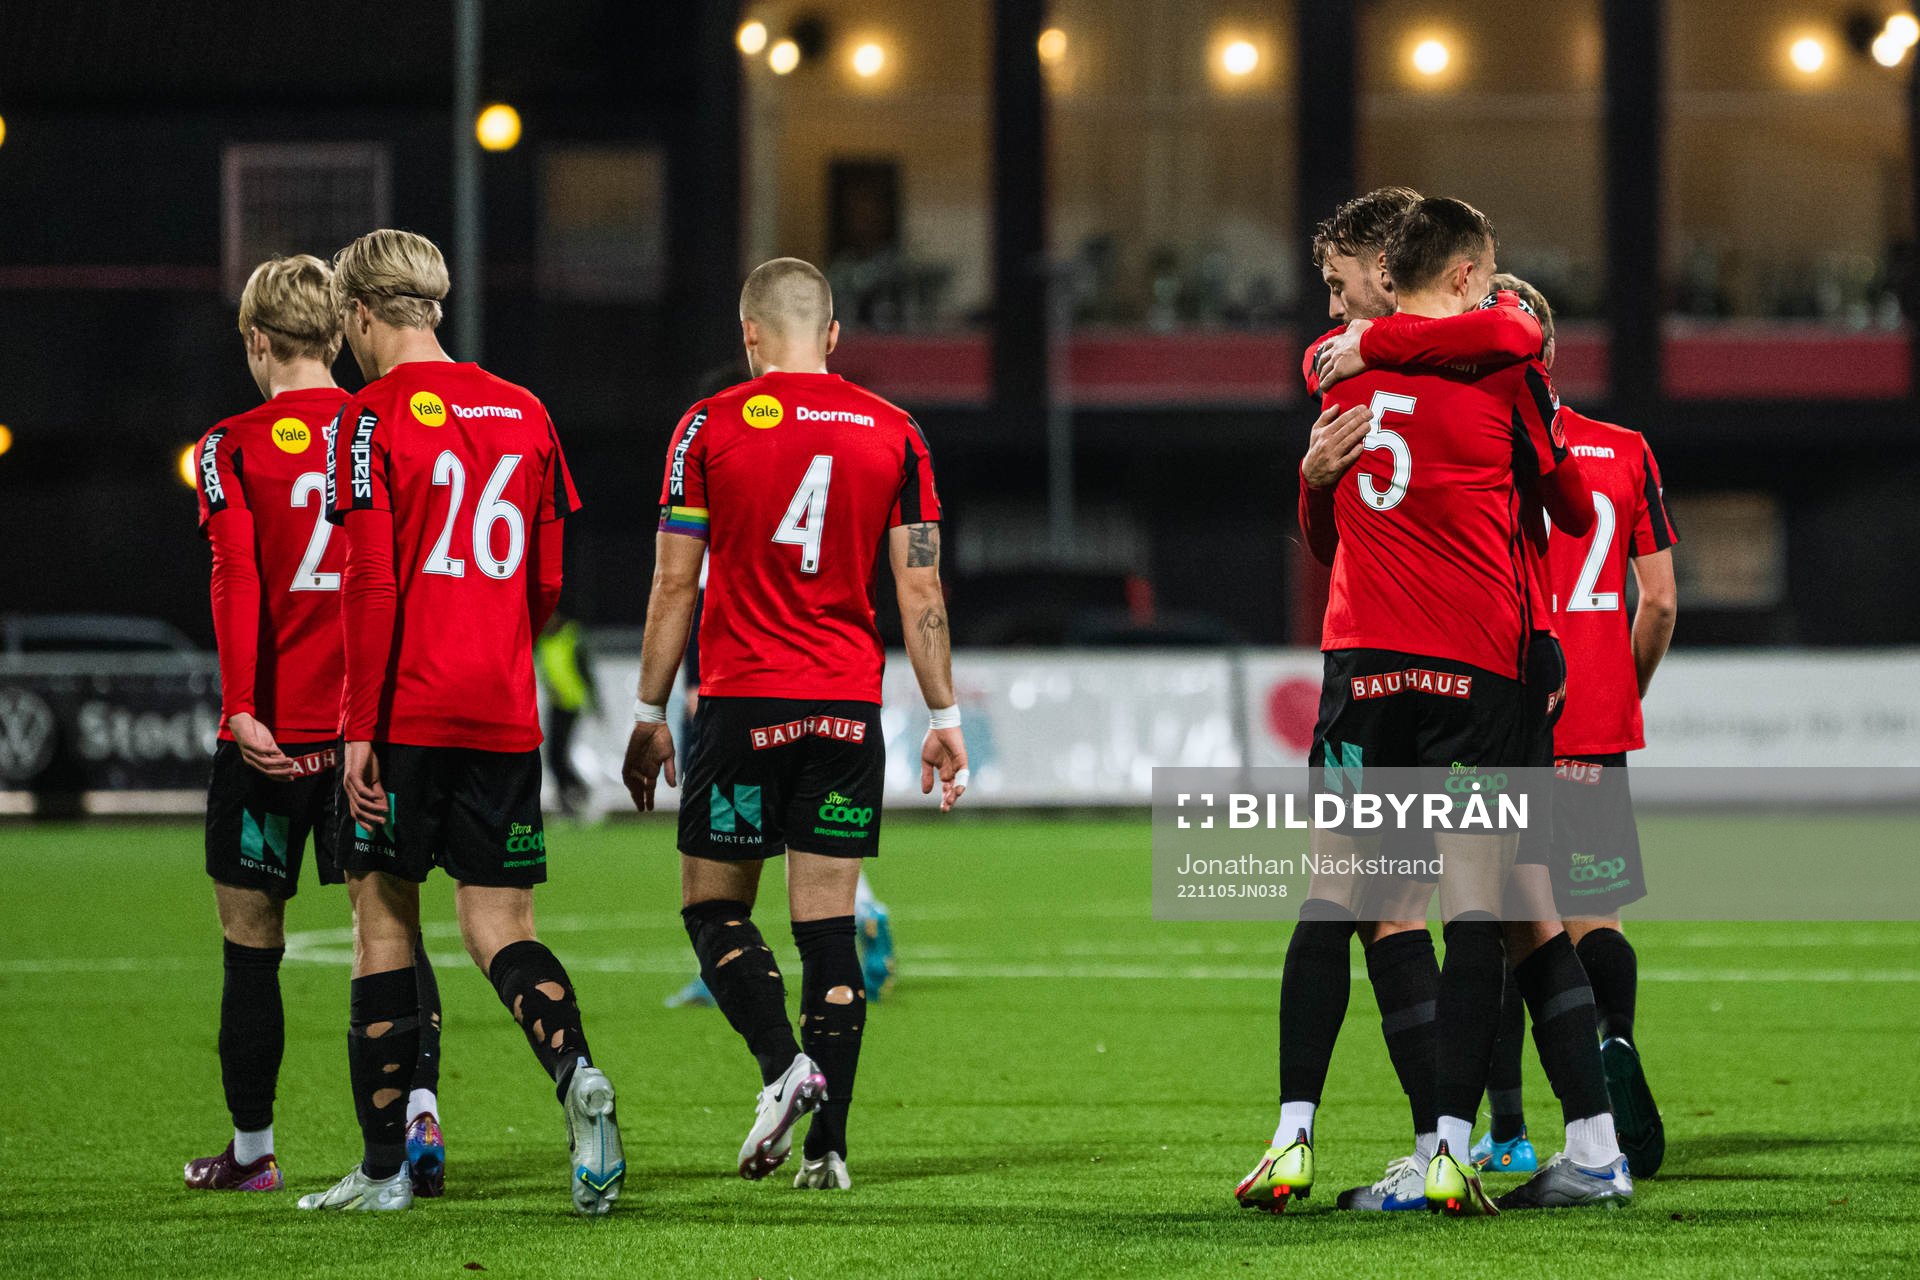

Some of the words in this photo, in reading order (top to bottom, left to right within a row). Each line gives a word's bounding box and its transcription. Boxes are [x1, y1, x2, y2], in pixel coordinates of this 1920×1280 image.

[413, 401, 444, 417] Yale
[451, 403, 523, 421] Doorman
[746, 403, 780, 418] Yale
[796, 406, 875, 427] Doorman
[274, 427, 307, 443] Yale
[351, 415, 378, 498] stadium
[669, 413, 707, 496] stadium
[1357, 390, 1417, 511] 5
[200, 432, 224, 503] stadium
[422, 449, 525, 580] 26
[771, 454, 833, 574] 4
[1354, 671, 1470, 697] BAUHAUS
[753, 718, 866, 748] BAUHAUS
[1449, 761, 1477, 775] Stora
[1444, 773, 1508, 795] coop
[819, 804, 873, 827] coop
[509, 822, 532, 836] Stora
[709, 832, 763, 845] NORTEAM
[1569, 856, 1626, 882] coop
